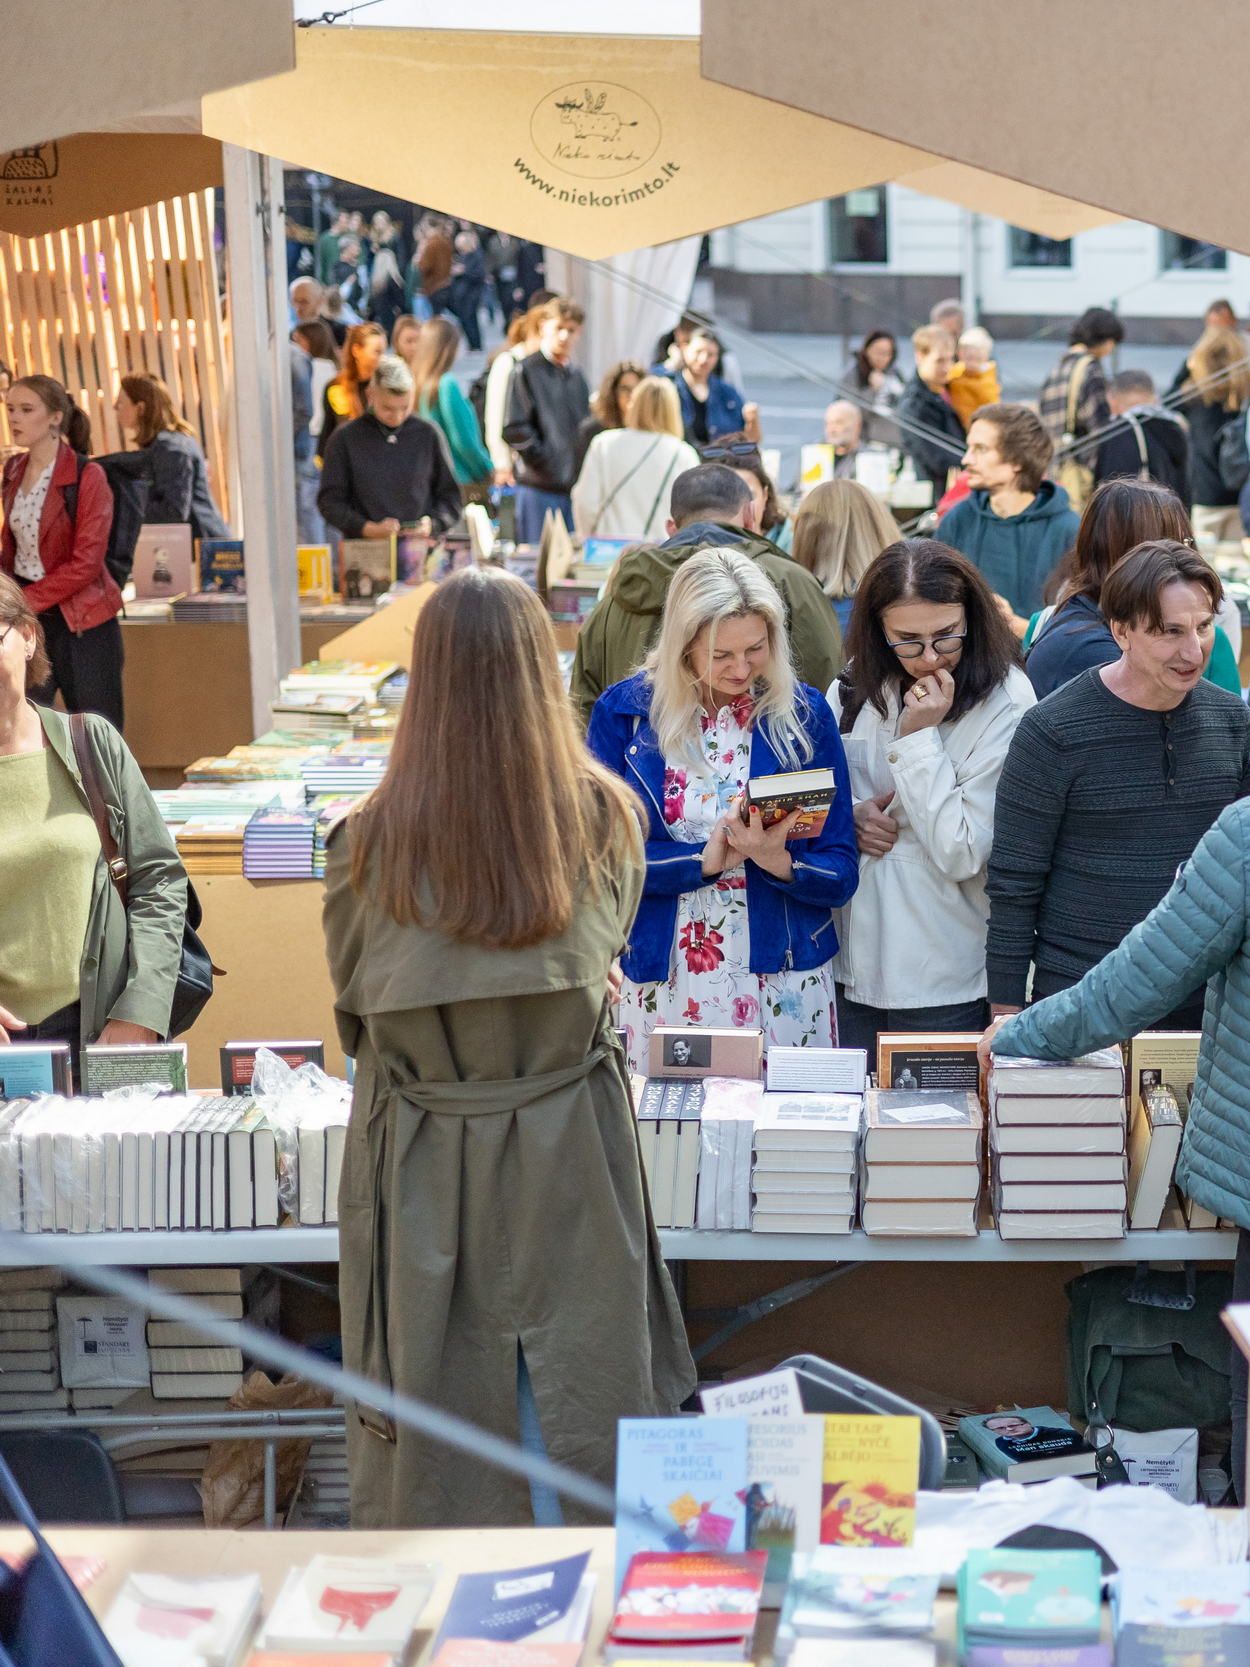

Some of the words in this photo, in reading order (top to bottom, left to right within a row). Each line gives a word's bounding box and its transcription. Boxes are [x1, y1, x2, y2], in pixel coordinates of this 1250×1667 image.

[514, 157, 681, 207] www.niekorimto.lt
[627, 1428, 704, 1440] PITAGORAS
[825, 1449, 872, 1464] ALBĖJO
